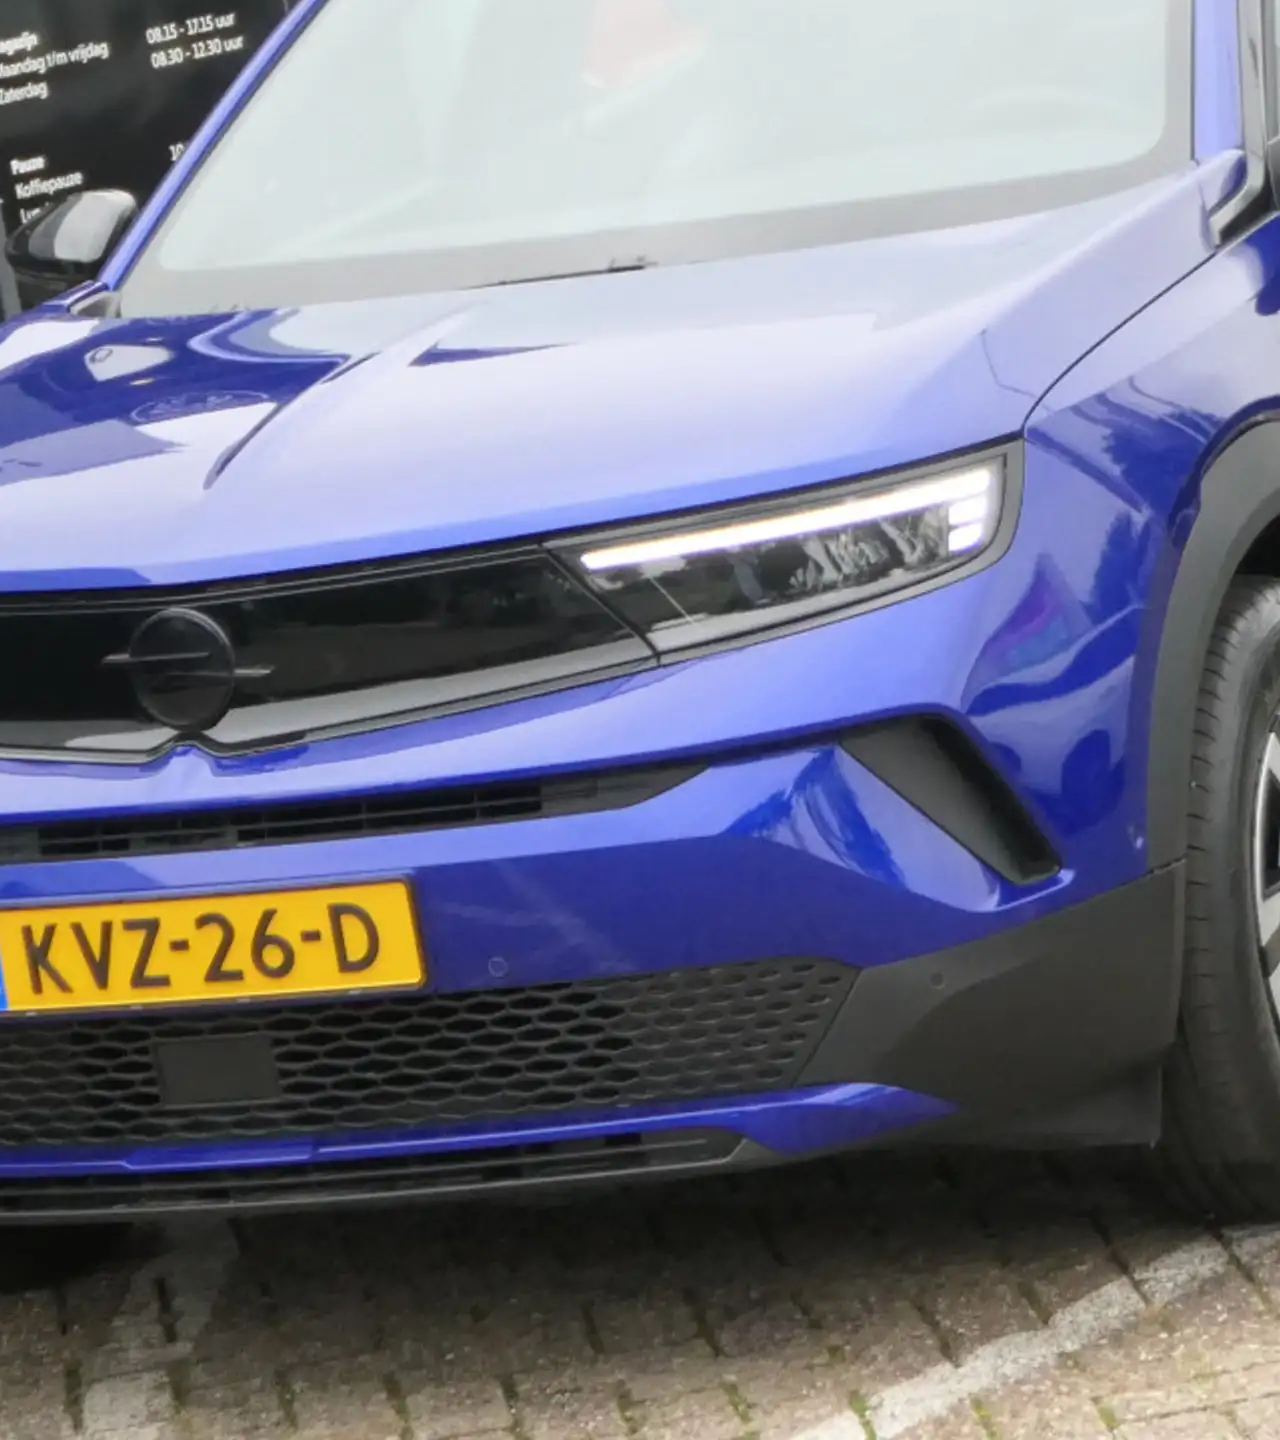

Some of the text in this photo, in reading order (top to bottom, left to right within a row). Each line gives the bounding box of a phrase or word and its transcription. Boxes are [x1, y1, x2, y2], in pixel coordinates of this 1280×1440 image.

[215, 13, 236, 29] uur
[68, 41, 109, 64] vrijdag
[223, 36, 244, 51] uur
[14, 171, 83, 200] Koffiepauze
[21, 902, 381, 994] KVZ-26-D
